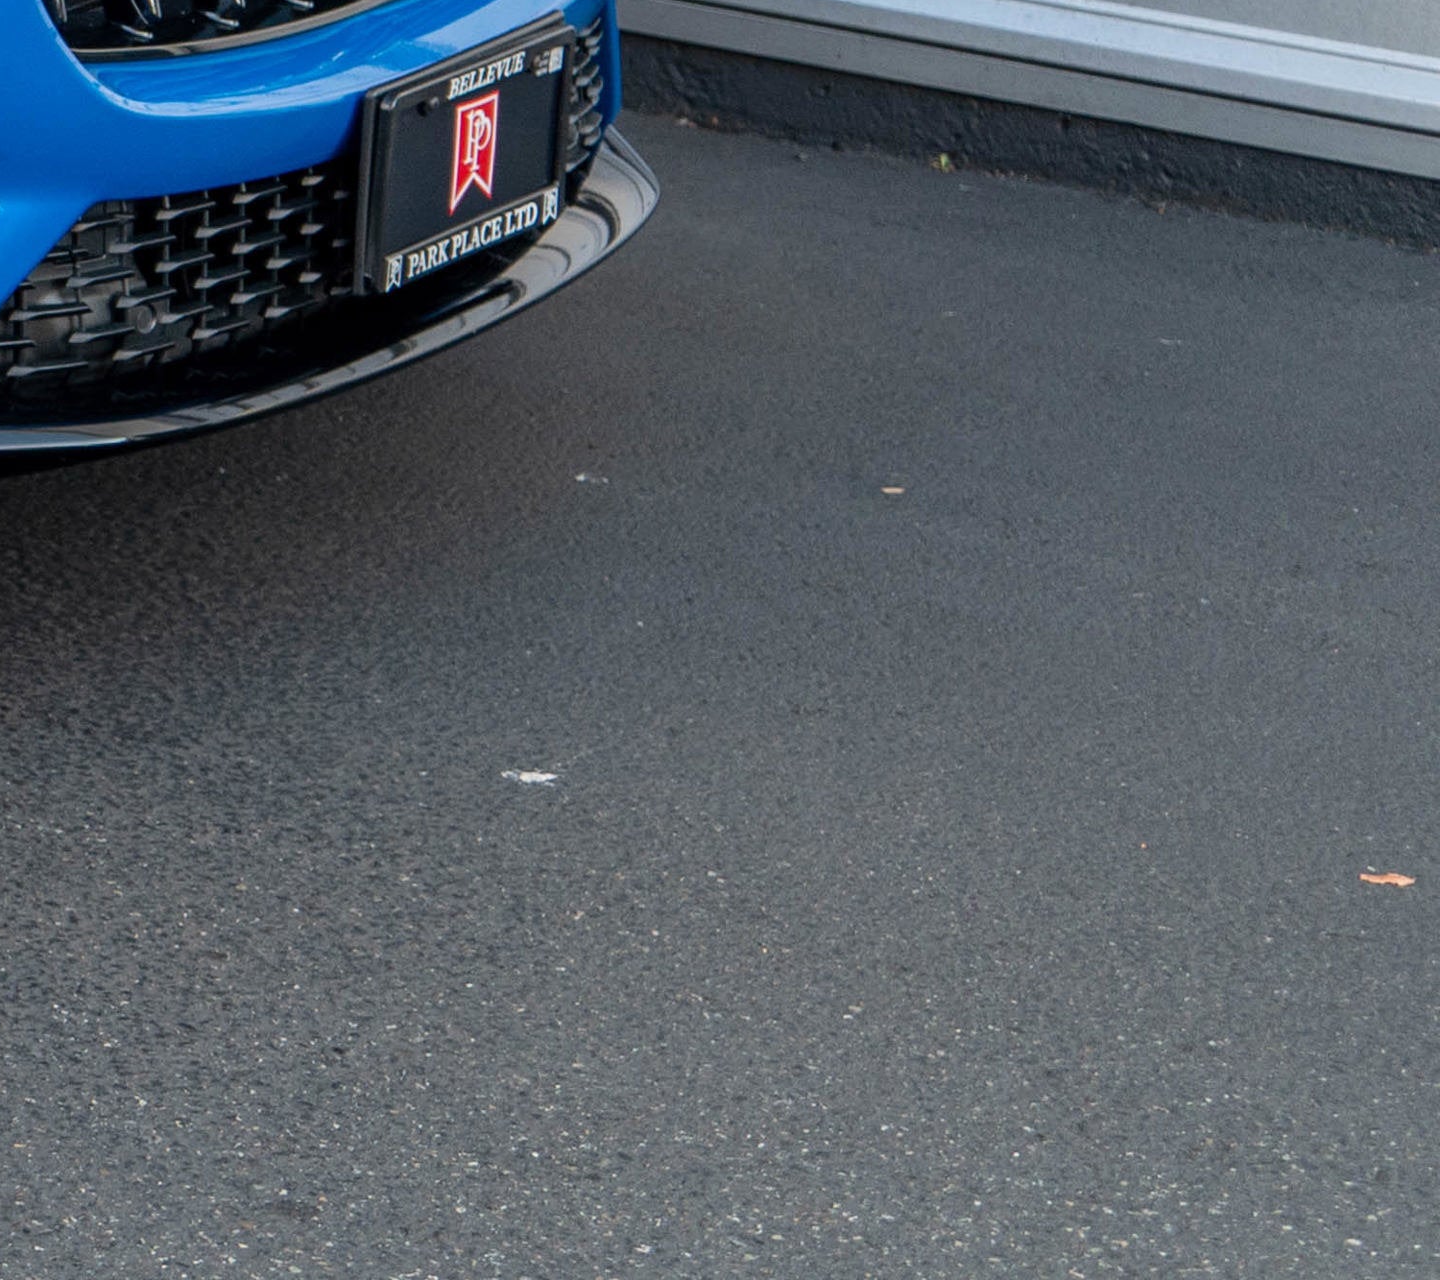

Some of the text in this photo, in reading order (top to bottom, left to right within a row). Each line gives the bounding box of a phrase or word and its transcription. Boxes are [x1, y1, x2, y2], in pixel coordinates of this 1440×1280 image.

[448, 51, 526, 100] BELLEVUE
[407, 239, 449, 278] PARK
[451, 216, 501, 258] PLACE
[504, 201, 539, 236] LTD
